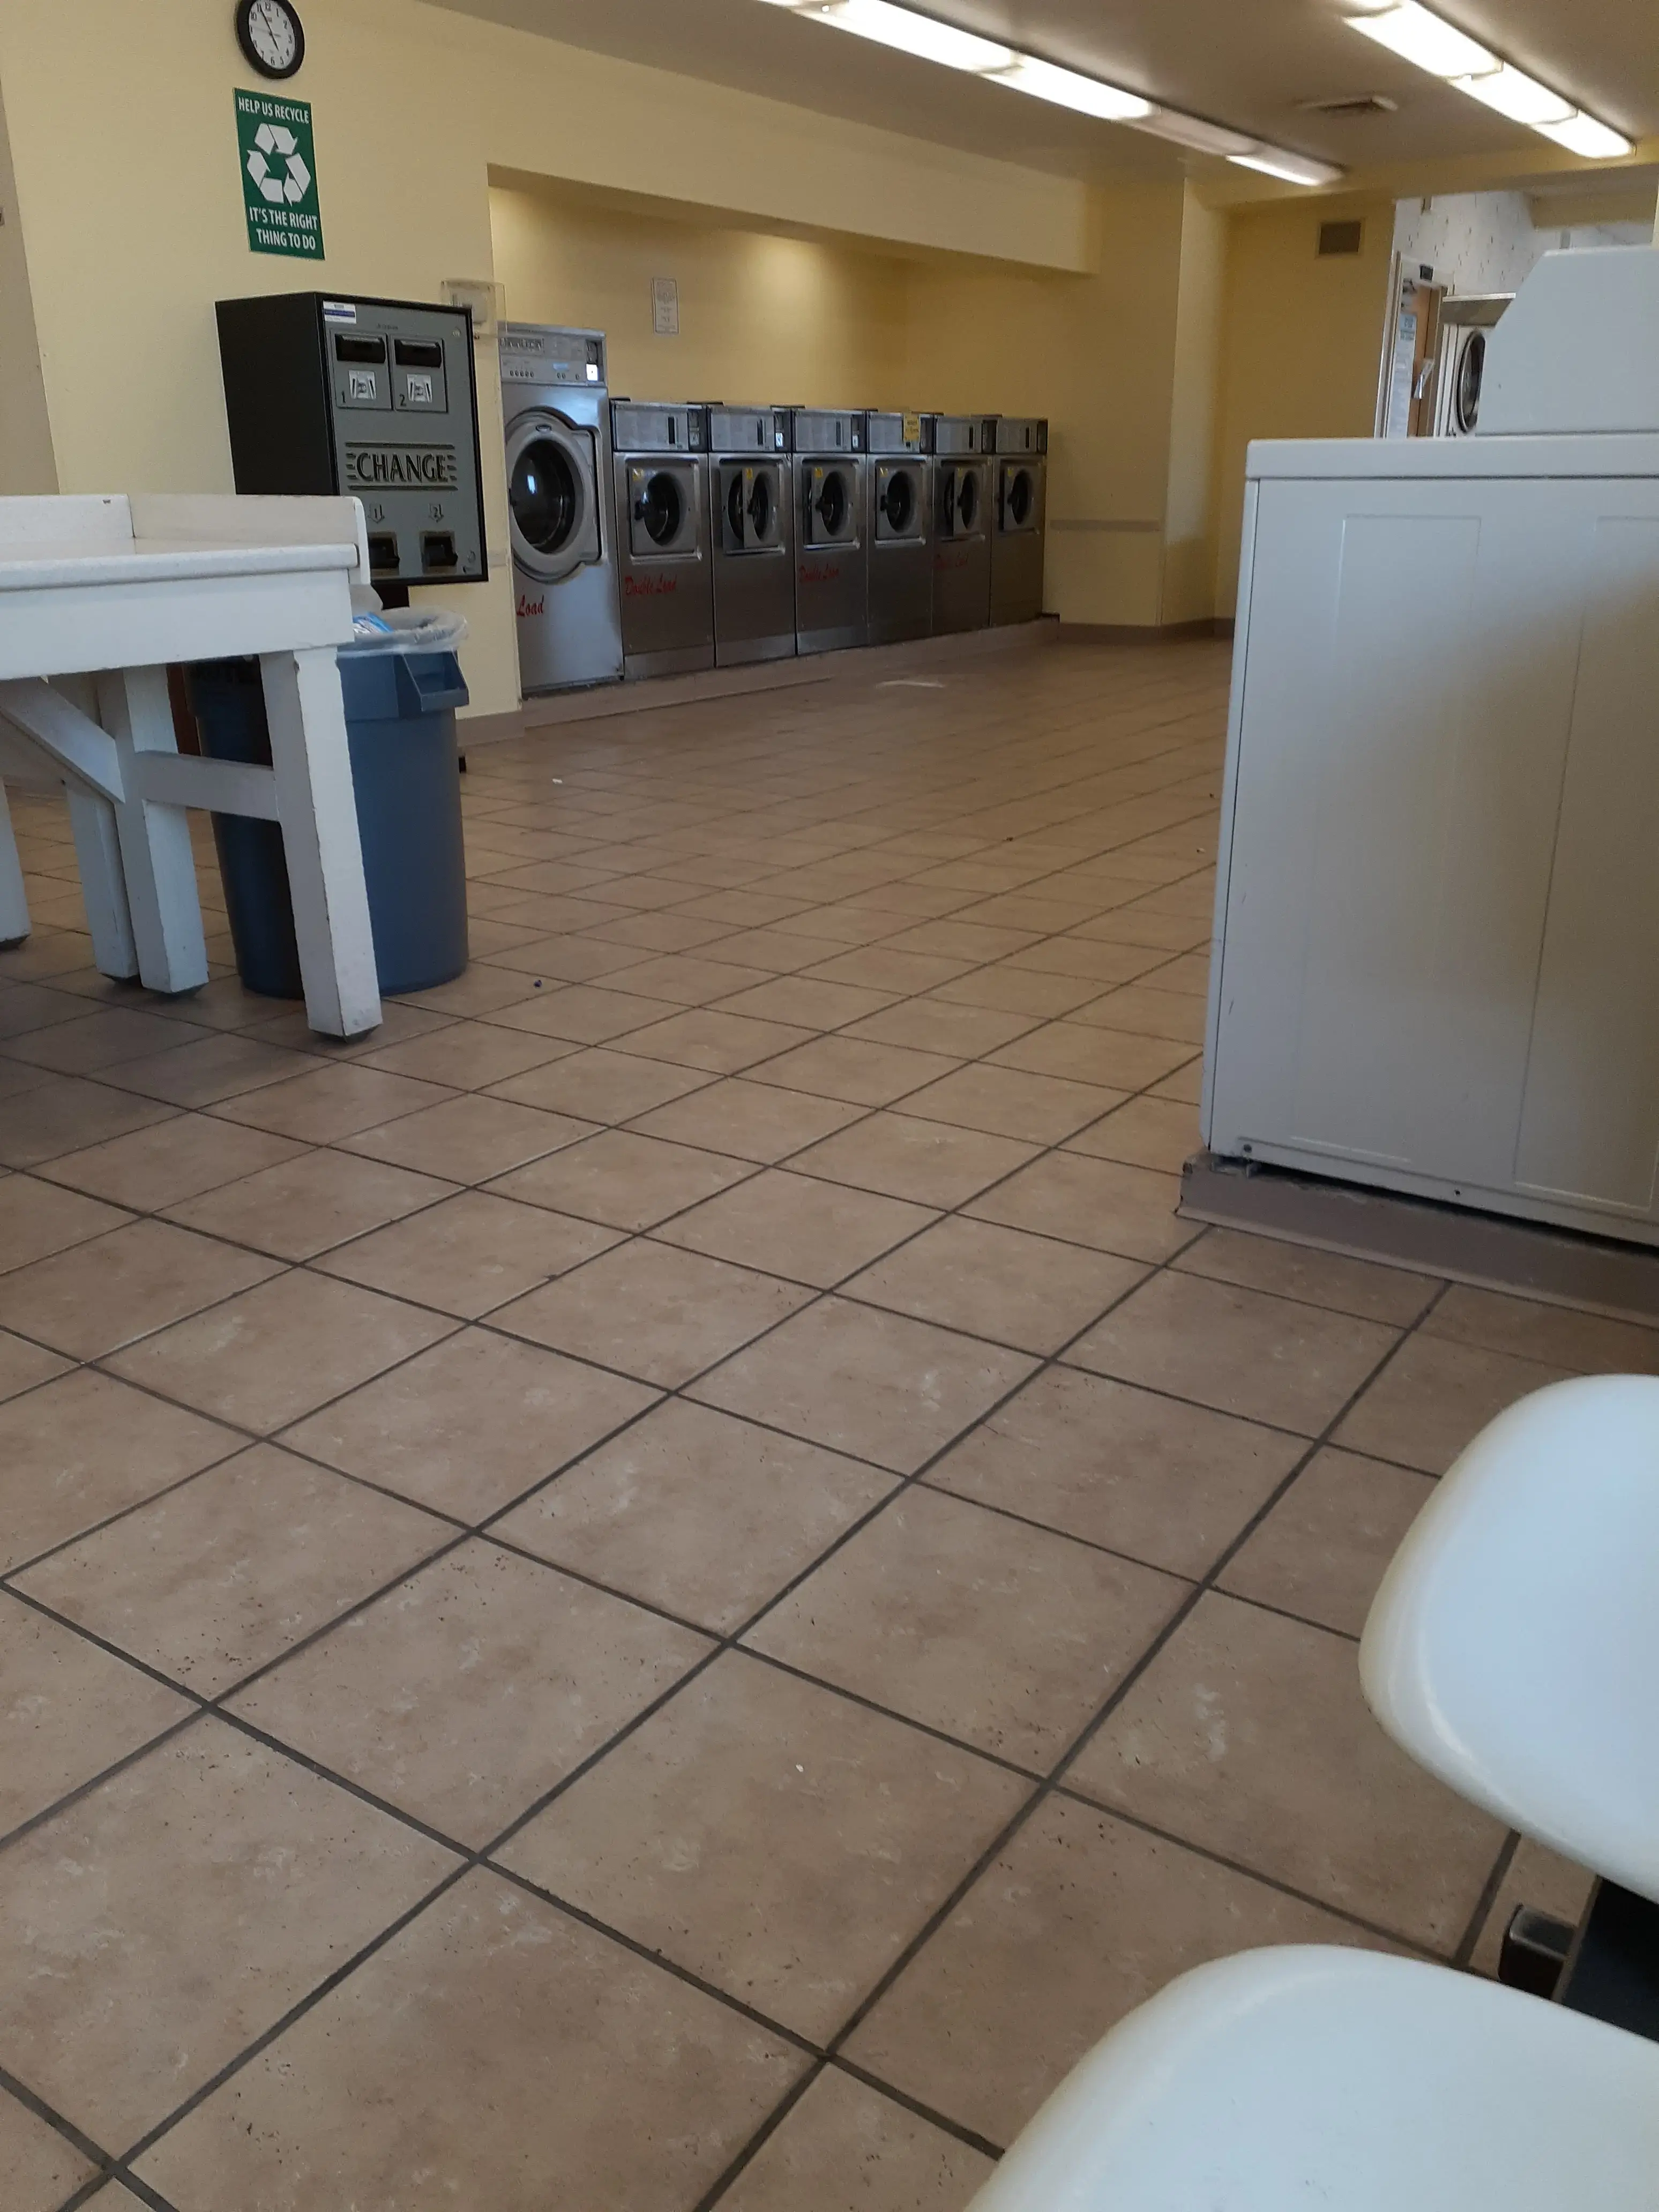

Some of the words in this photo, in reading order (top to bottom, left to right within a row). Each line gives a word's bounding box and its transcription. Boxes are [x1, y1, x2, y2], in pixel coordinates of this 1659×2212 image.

[237, 96, 260, 114] HELP
[261, 101, 273, 117] US
[274, 103, 309, 124] RECYCLE
[249, 206, 268, 224] IT'S
[268, 208, 288, 227] THE
[289, 212, 318, 231] RIGHT
[256, 228, 287, 248] THING
[288, 232, 301, 249] TO
[302, 234, 316, 250] DO
[341, 390, 346, 403] 1
[399, 393, 407, 407] 2
[356, 452, 448, 482] CHANGE
[516, 594, 544, 617] Load
